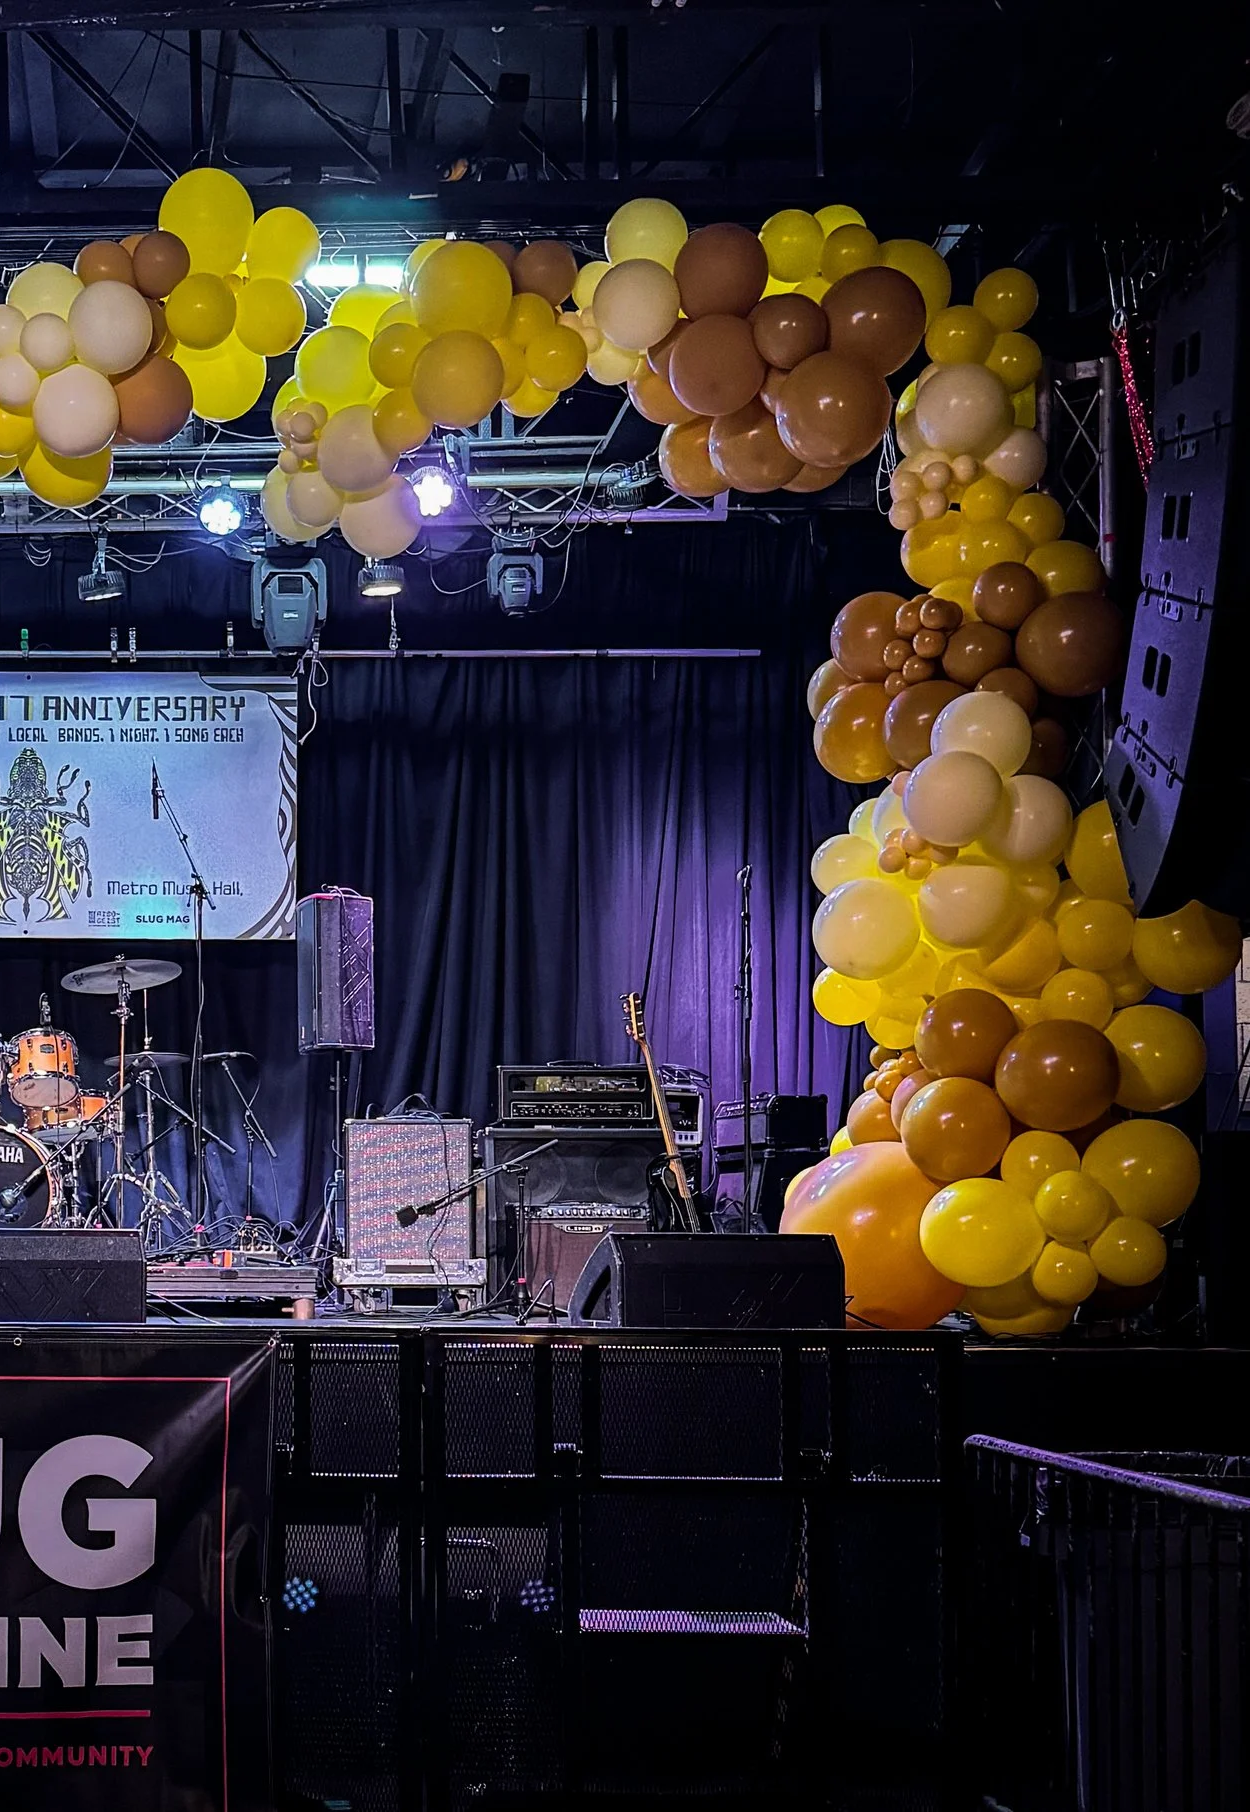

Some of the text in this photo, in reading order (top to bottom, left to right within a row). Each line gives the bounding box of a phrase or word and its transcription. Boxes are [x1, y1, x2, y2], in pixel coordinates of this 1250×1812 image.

[43, 695, 246, 722] ANNIVERSARY
[8, 727, 49, 742] LOCAL
[109, 727, 115, 742] 1
[164, 727, 170, 742] 1
[174, 727, 209, 742] SONG
[214, 727, 245, 742] EACH
[107, 881, 158, 896] Metro
[135, 915, 190, 924] SLUG MAG
